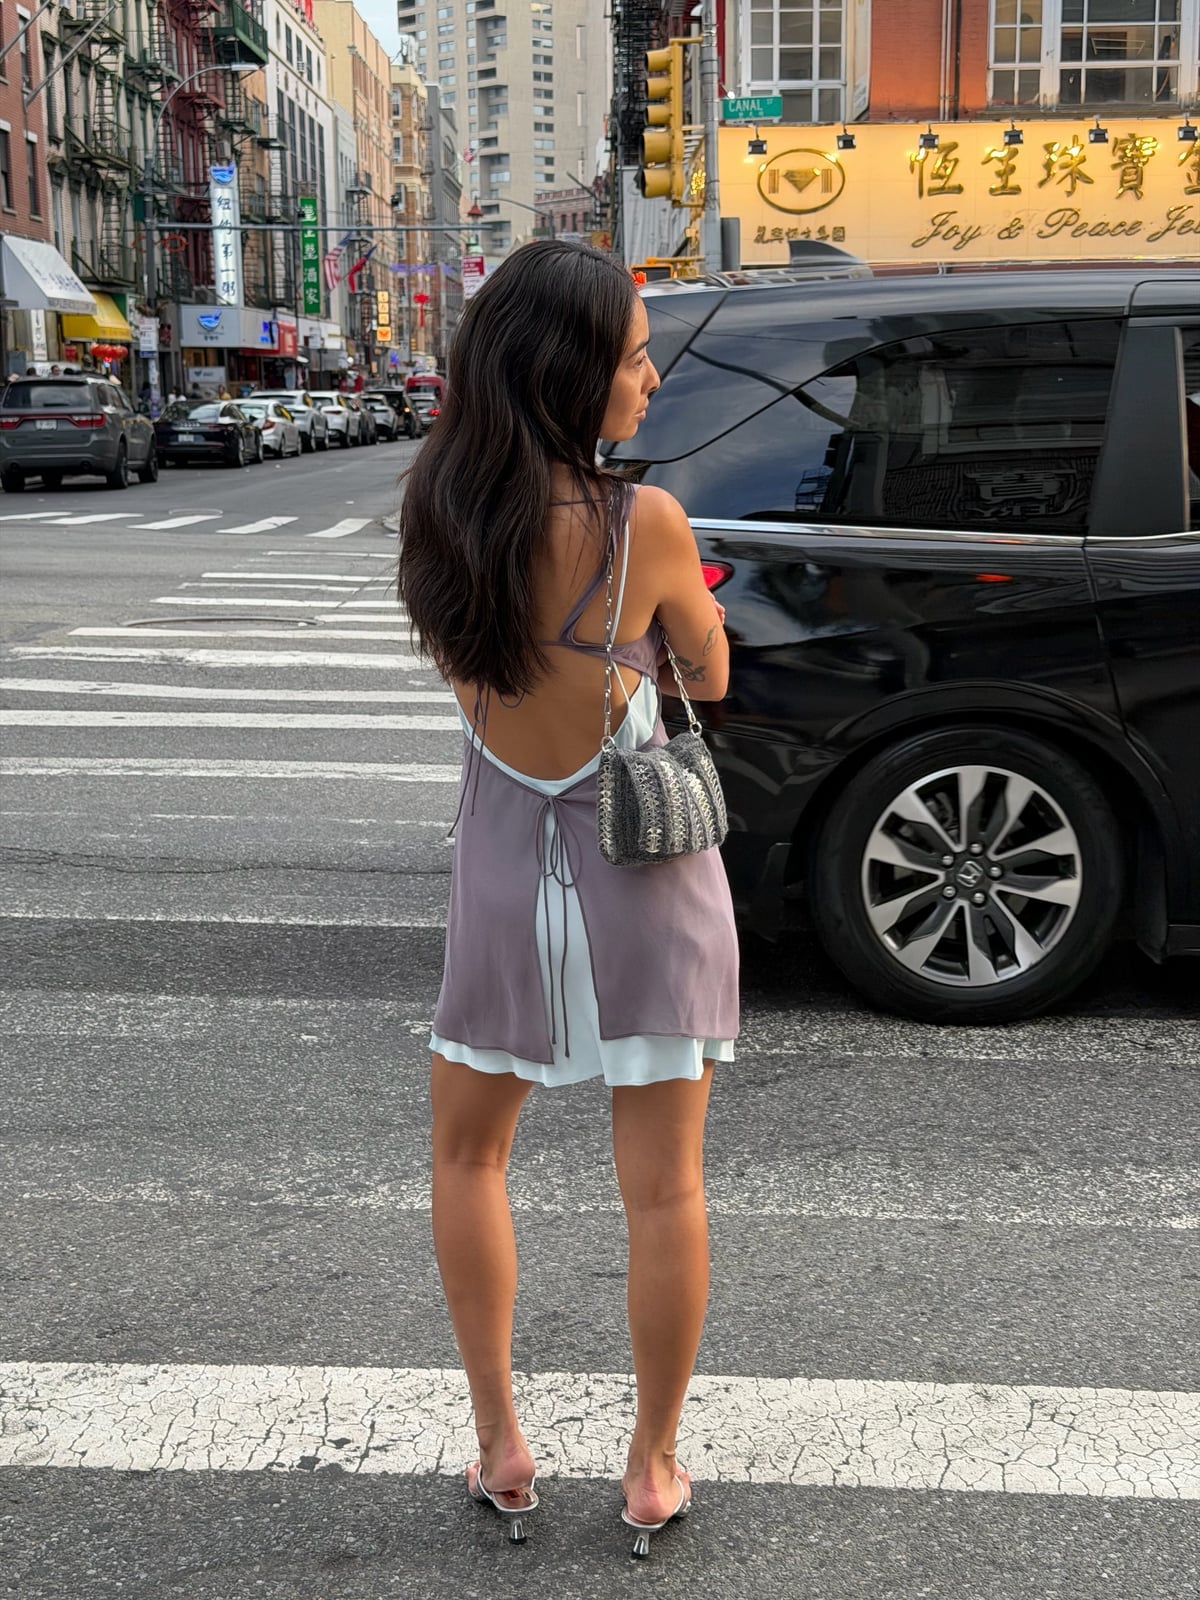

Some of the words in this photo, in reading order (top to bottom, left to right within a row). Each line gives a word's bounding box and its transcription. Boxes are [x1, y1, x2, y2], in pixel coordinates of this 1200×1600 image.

[728, 99, 763, 112] CANAL
[911, 210, 981, 250] Joy
[997, 216, 1024, 240] &
[1037, 207, 1143, 239] Peace
